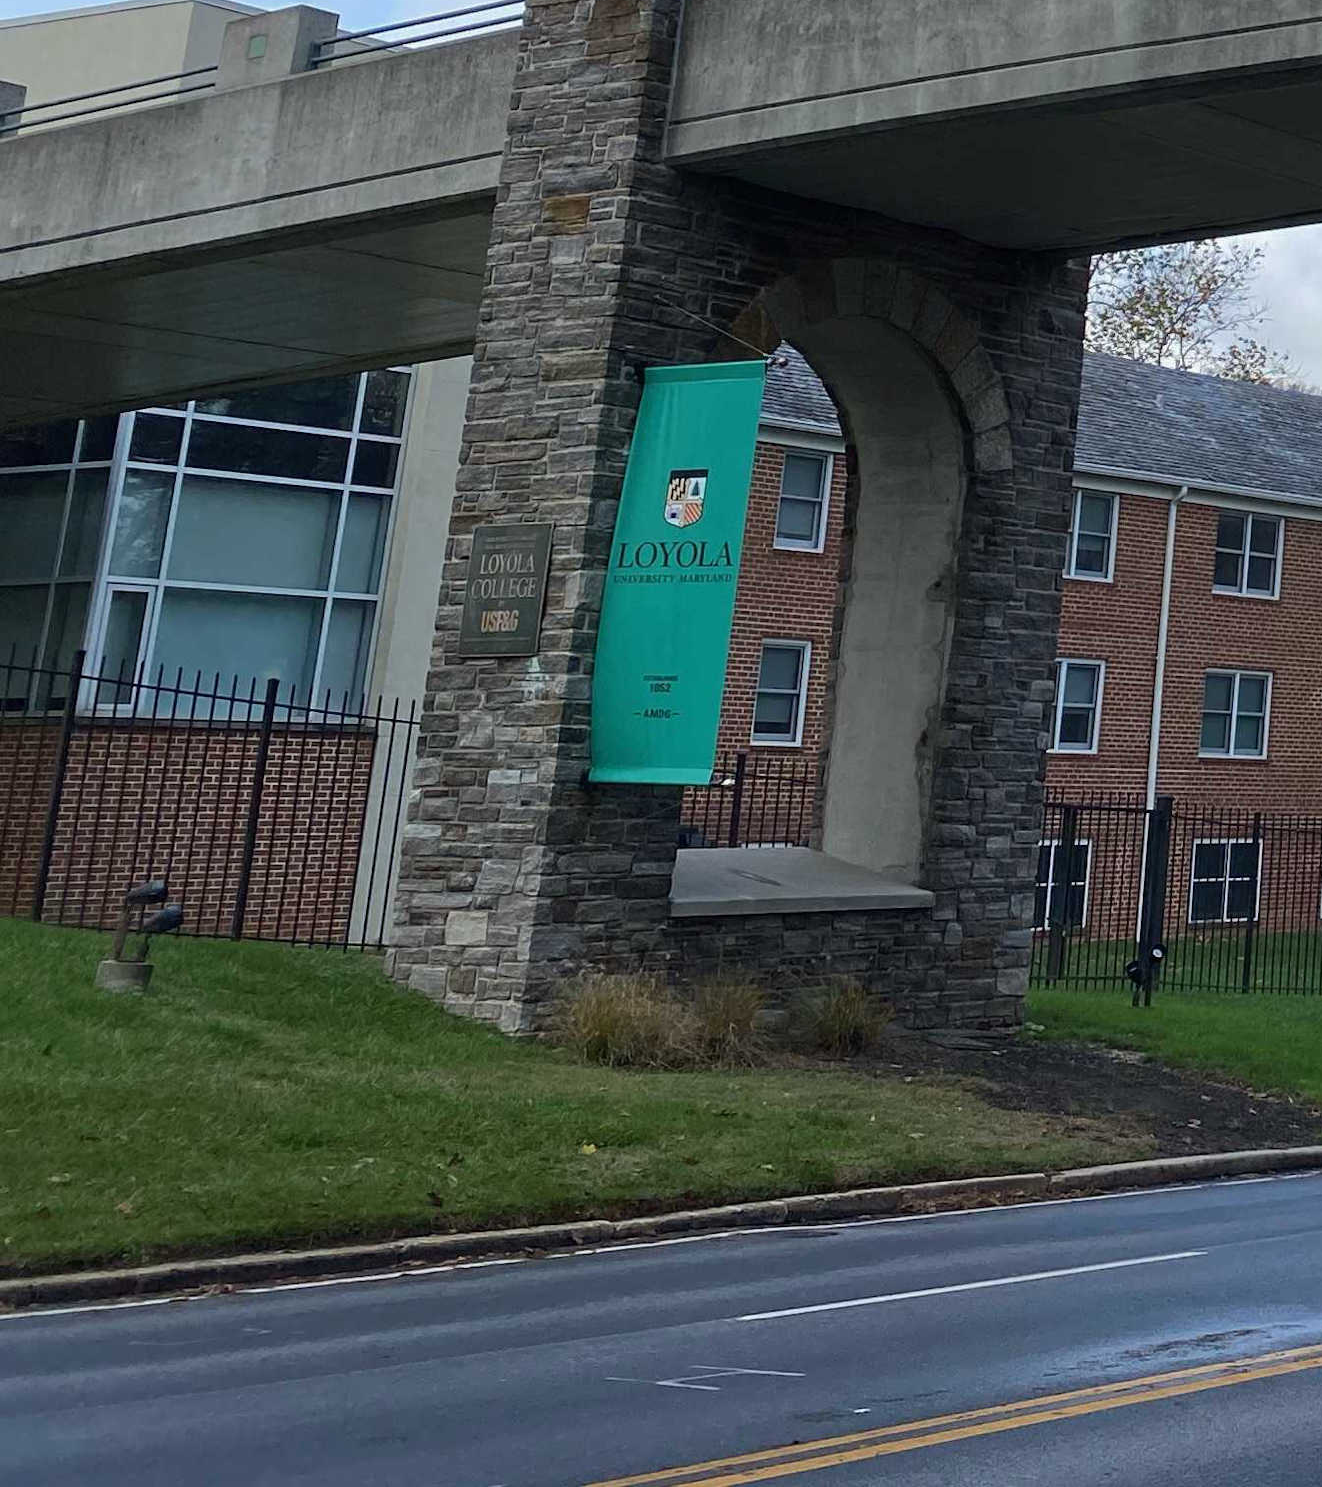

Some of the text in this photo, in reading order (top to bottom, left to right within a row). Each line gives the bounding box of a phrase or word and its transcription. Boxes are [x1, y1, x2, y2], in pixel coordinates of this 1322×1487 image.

[480, 553, 535, 575] LOYOLA
[616, 540, 733, 569] LOYOLA
[471, 576, 538, 600] COLLEGE
[613, 573, 732, 584] UNIVERSITY MARYLAND
[480, 610, 519, 633] USF&G
